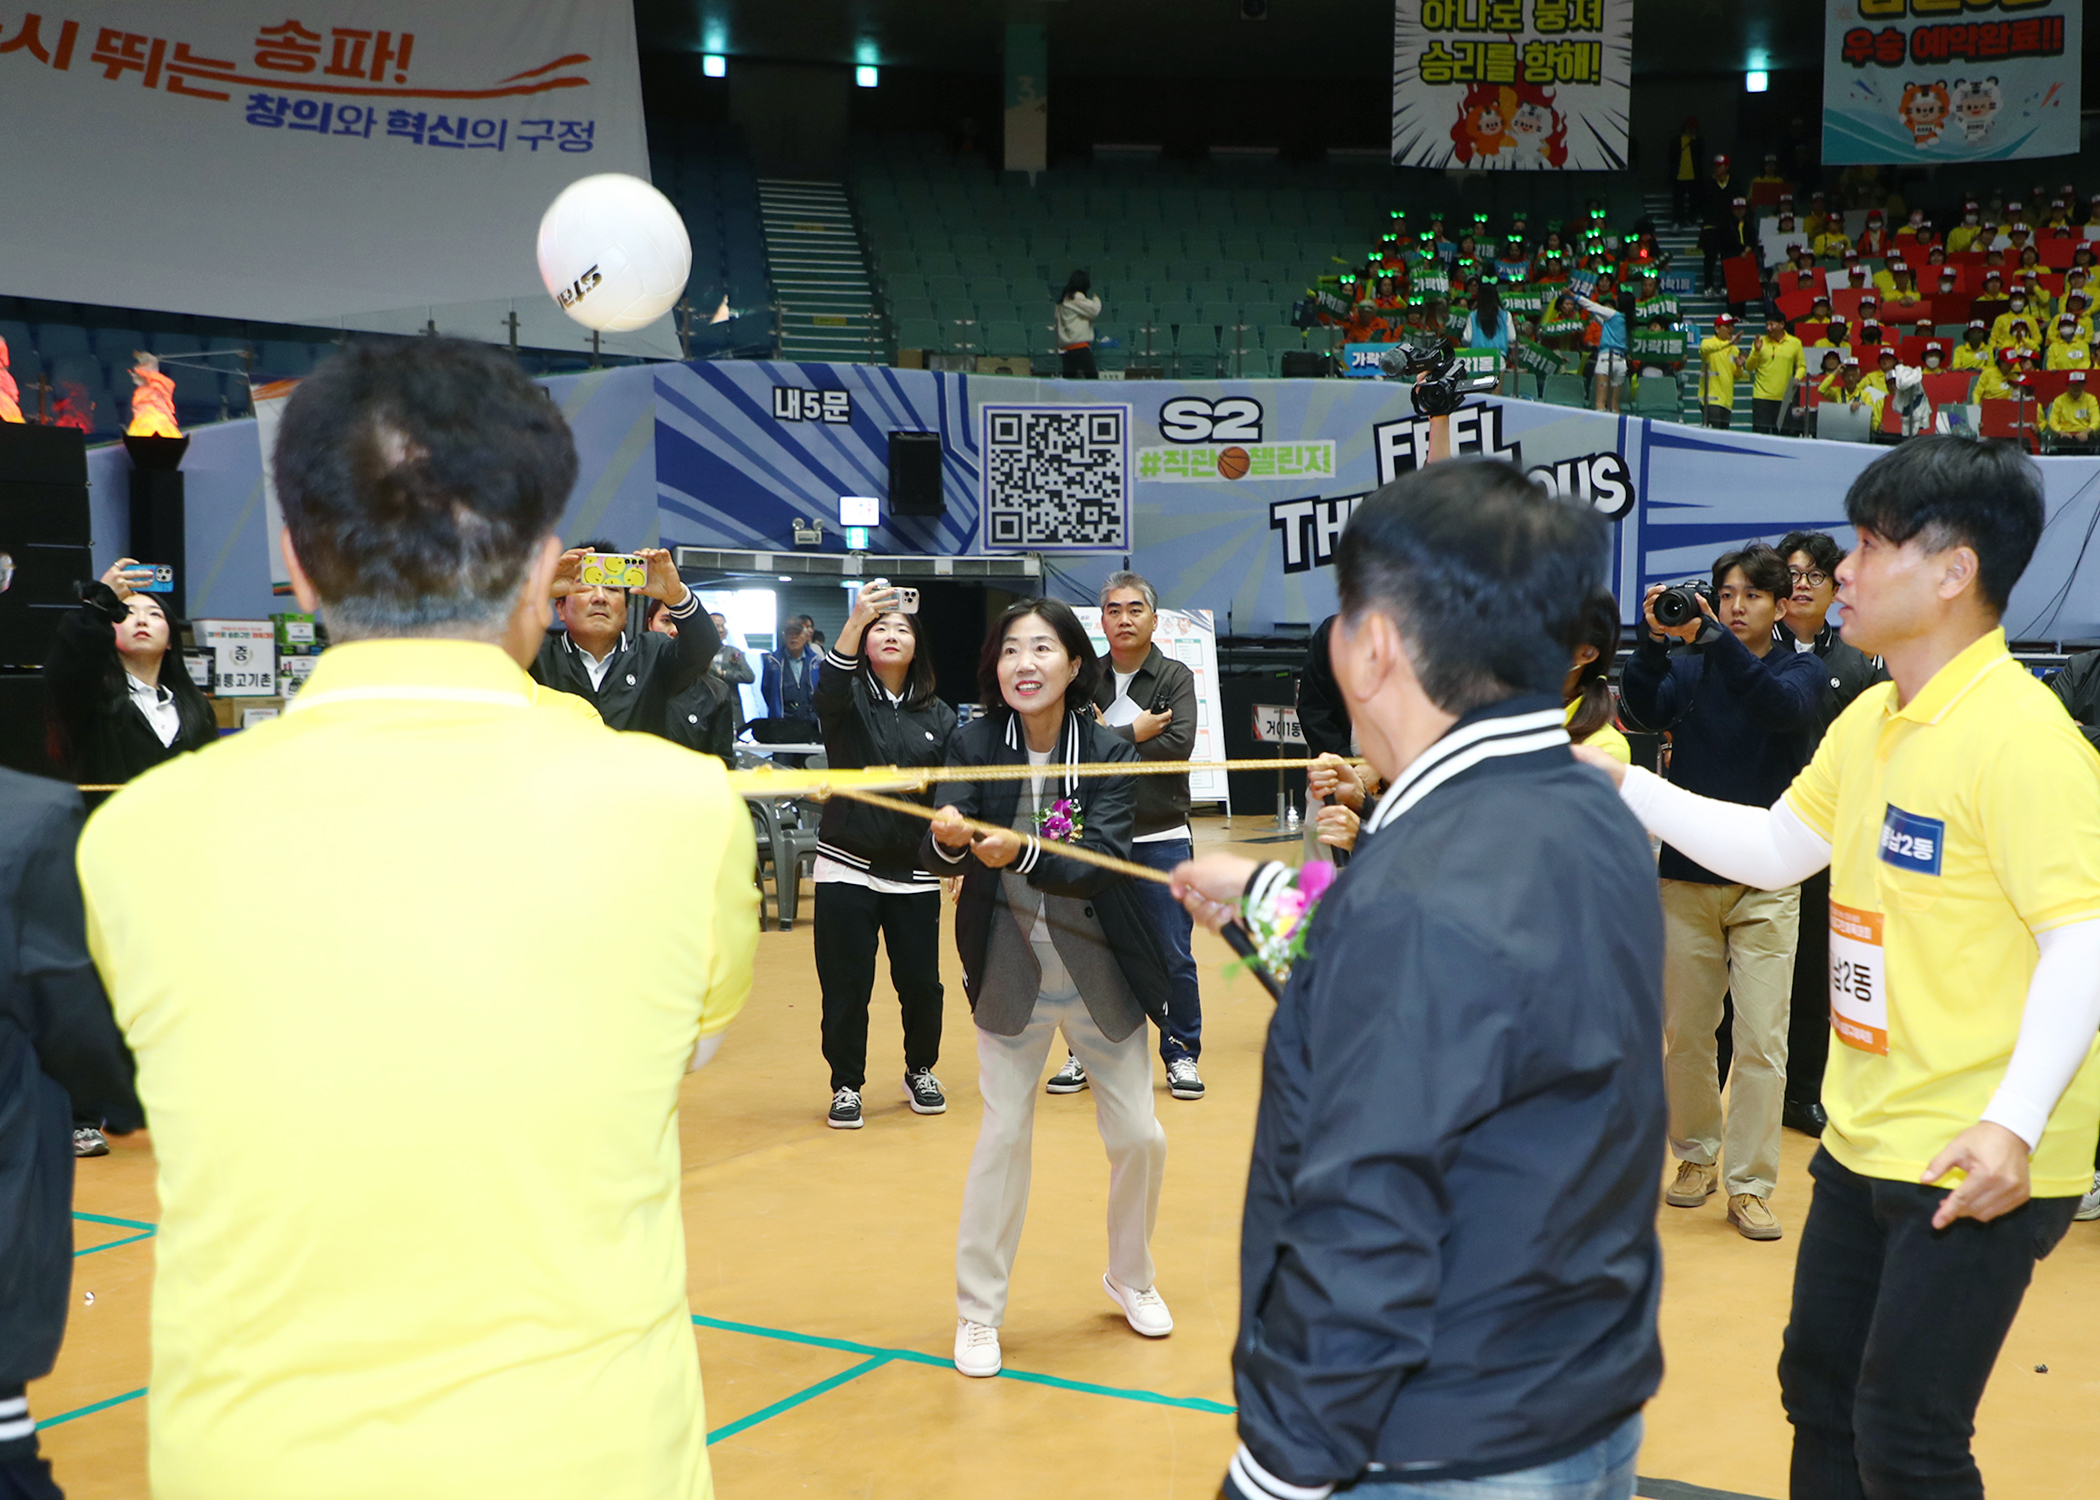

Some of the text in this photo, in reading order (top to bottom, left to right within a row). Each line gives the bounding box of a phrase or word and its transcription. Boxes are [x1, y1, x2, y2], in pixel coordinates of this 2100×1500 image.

[1422, 0, 1523, 31] 하나로
[0, 13, 415, 102] 시 뛰는 송파!
[1842, 15, 2065, 67] 우승 예약완료!!
[1419, 41, 1602, 85] 승리를 향해!
[245, 93, 596, 153] 창의와 혁신의 구정
[1352, 351, 1382, 367] 가락
[1633, 338, 1683, 355] 가락1동
[773, 387, 850, 424] 내5문
[1160, 397, 1264, 444] S2
[1249, 445, 1331, 475] 챌린지
